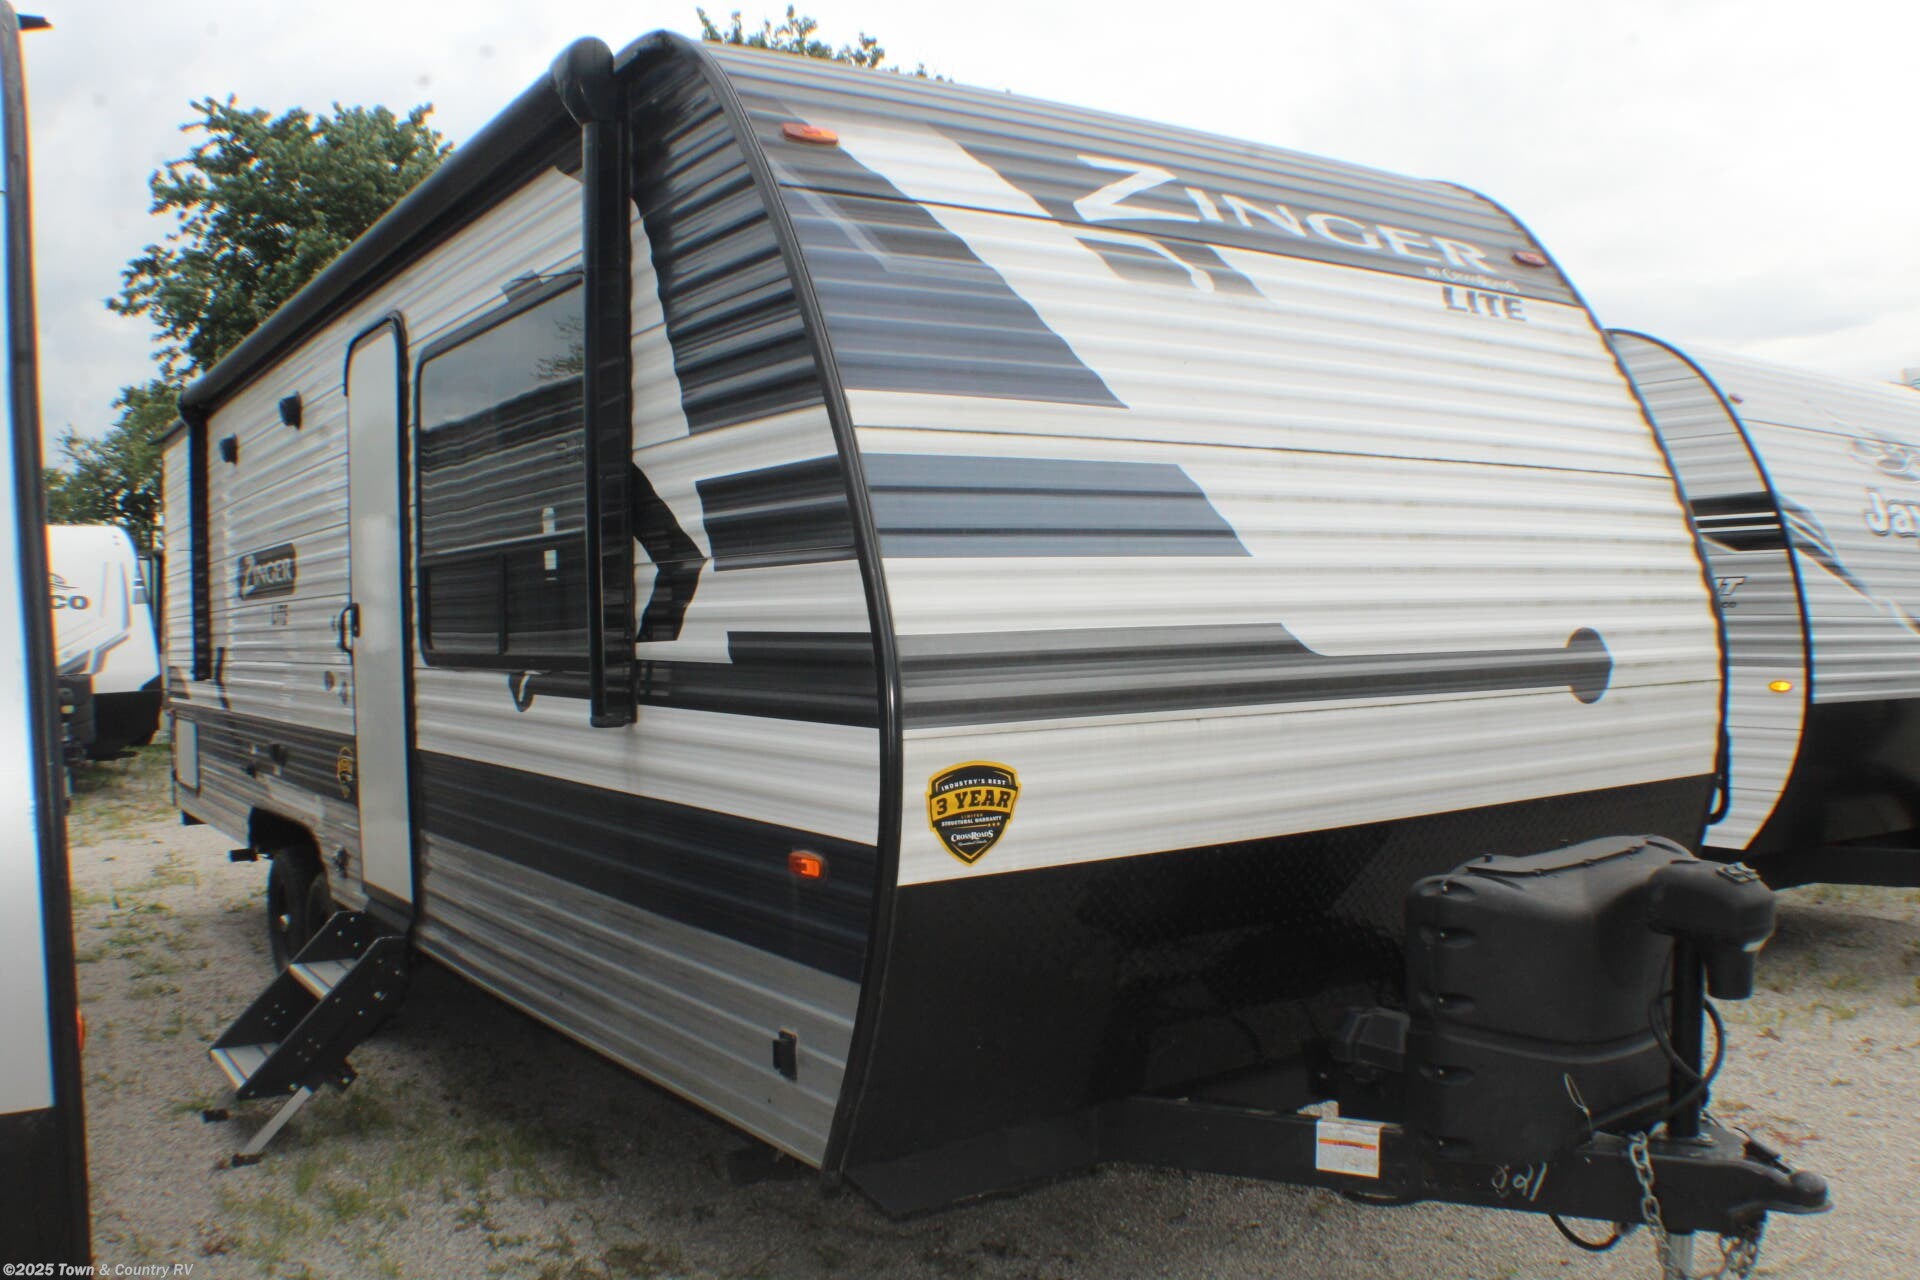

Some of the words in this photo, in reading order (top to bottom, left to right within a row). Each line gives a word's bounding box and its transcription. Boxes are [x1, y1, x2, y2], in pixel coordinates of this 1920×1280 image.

[1073, 155, 1492, 271] ZINGER
[1442, 286, 1526, 321] LITE
[240, 554, 292, 597] ZINGER
[49, 594, 90, 610] CO
[941, 779, 985, 791] INDUSTRY'S
[936, 797, 948, 815] 3
[955, 790, 1010, 808] YEAR
